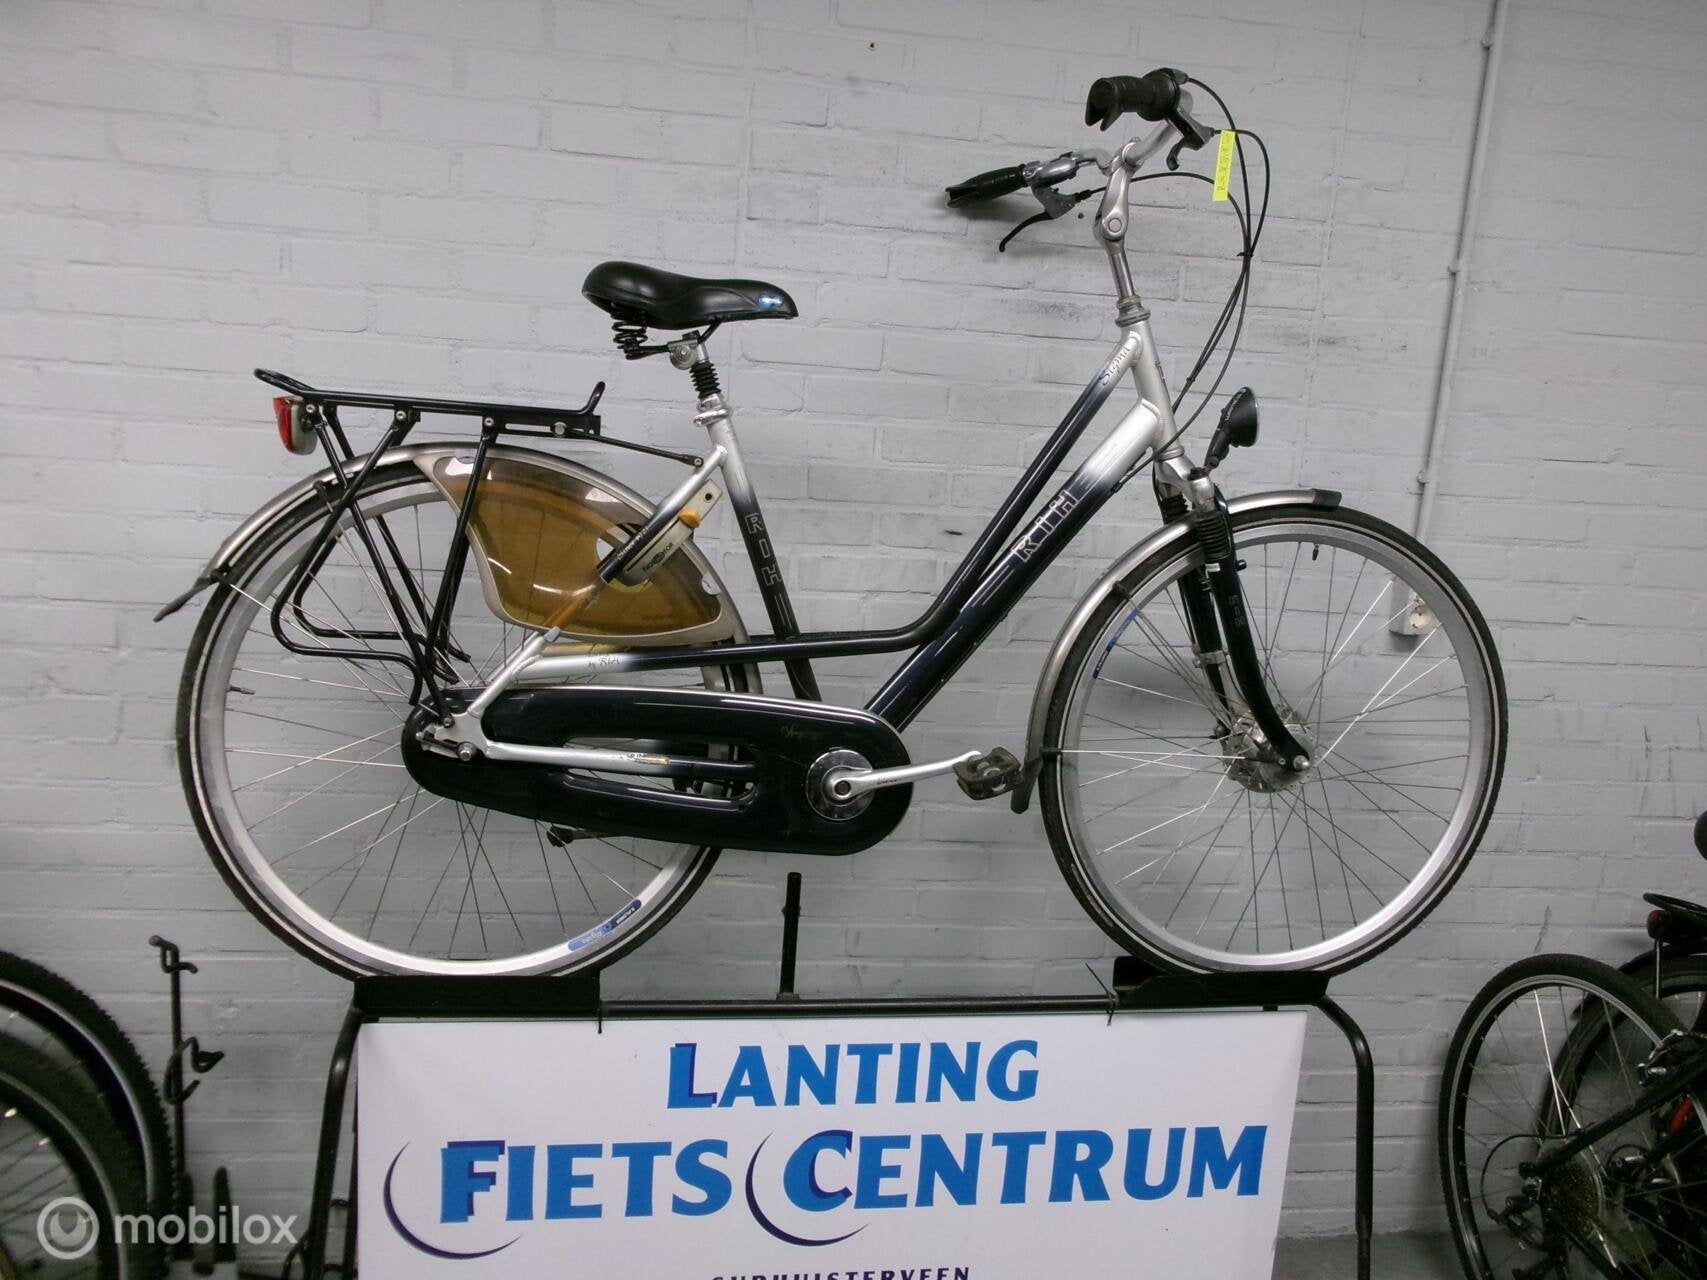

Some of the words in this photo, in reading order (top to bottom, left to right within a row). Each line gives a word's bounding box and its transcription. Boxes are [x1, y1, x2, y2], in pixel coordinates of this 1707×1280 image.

[1011, 489, 1080, 562] RIH
[668, 1040, 1038, 1110] LANTING
[441, 1138, 733, 1223] FIETS
[783, 1126, 1268, 1212] CENTRUM
